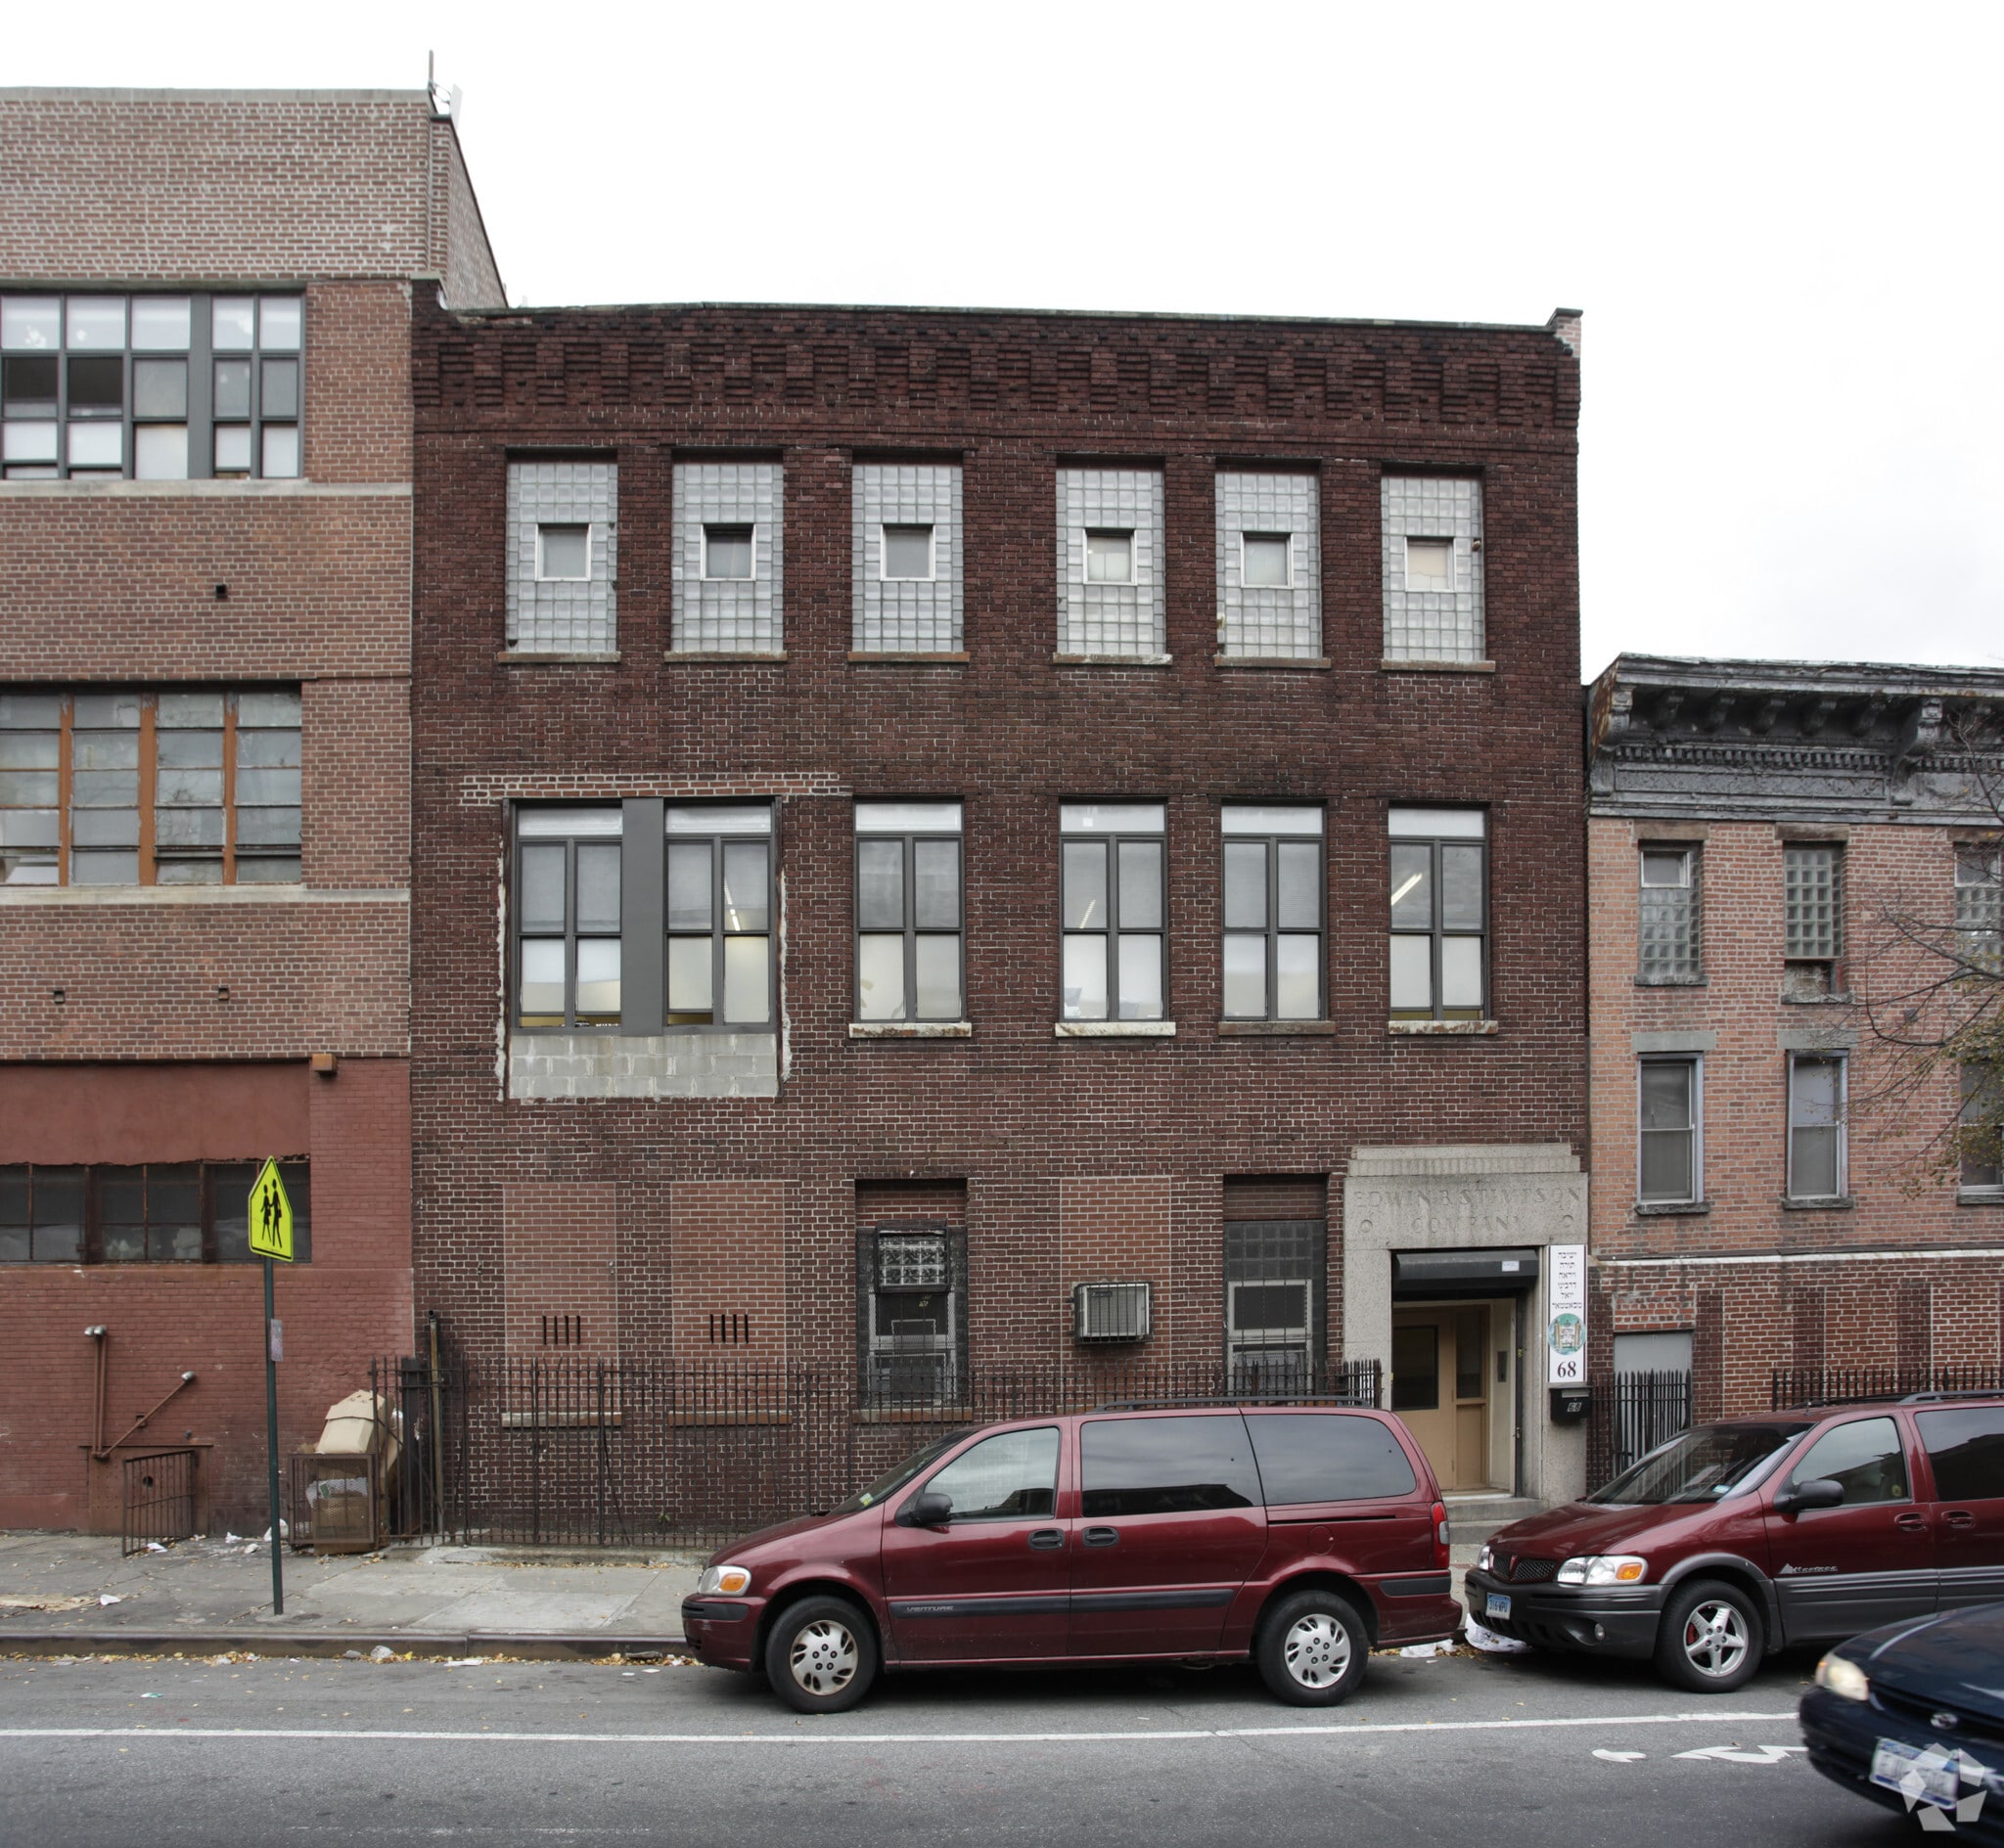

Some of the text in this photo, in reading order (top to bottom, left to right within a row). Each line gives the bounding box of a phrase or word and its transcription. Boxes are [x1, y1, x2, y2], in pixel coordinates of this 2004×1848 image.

[1353, 1189, 1432, 1207] EDWIN
[1459, 1187, 1581, 1205] STIMPSON
[1557, 1360, 1577, 1378] 68
[1569, 1403, 1580, 1412] 68
